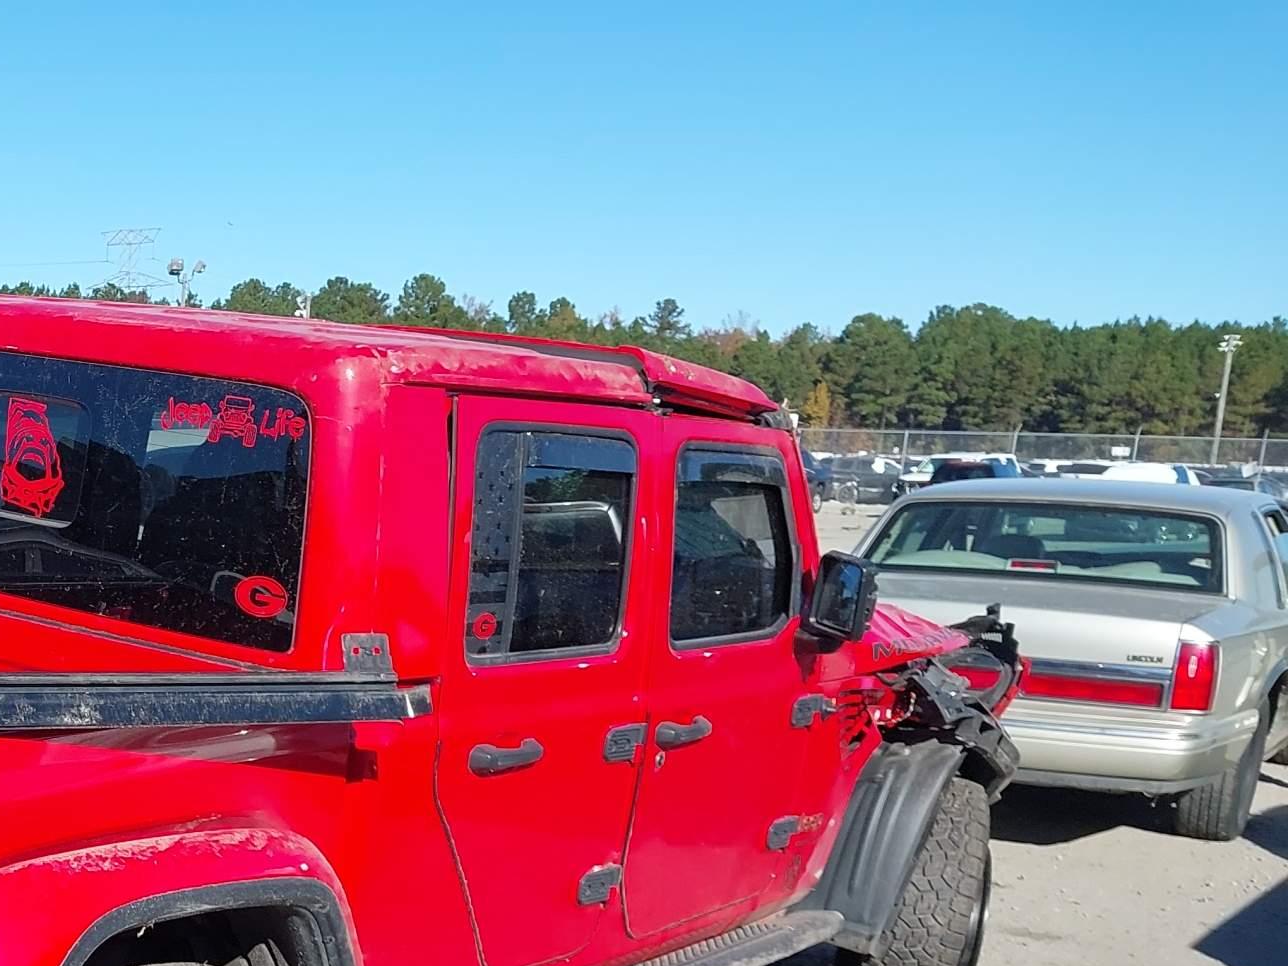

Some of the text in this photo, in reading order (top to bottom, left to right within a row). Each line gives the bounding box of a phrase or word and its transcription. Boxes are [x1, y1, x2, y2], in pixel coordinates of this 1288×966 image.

[161, 397, 306, 441] Jeep Life
[235, 576, 288, 617] G
